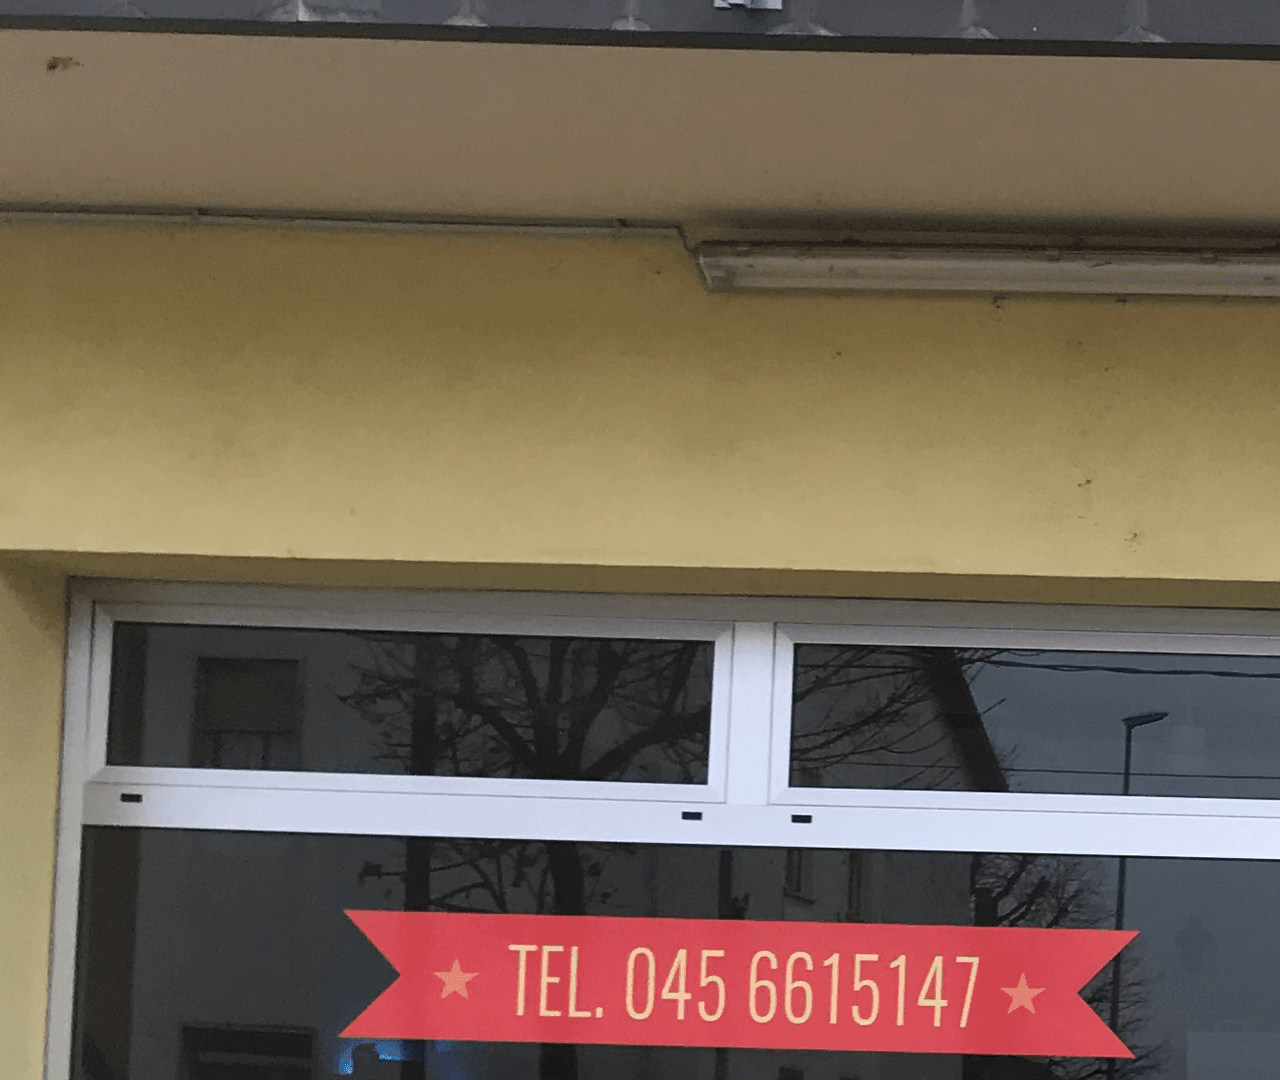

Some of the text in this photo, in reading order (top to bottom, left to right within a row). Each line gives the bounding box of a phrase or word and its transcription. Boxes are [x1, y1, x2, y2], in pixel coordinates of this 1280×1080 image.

[508, 944, 980, 1028] TEL. 045 6615147
